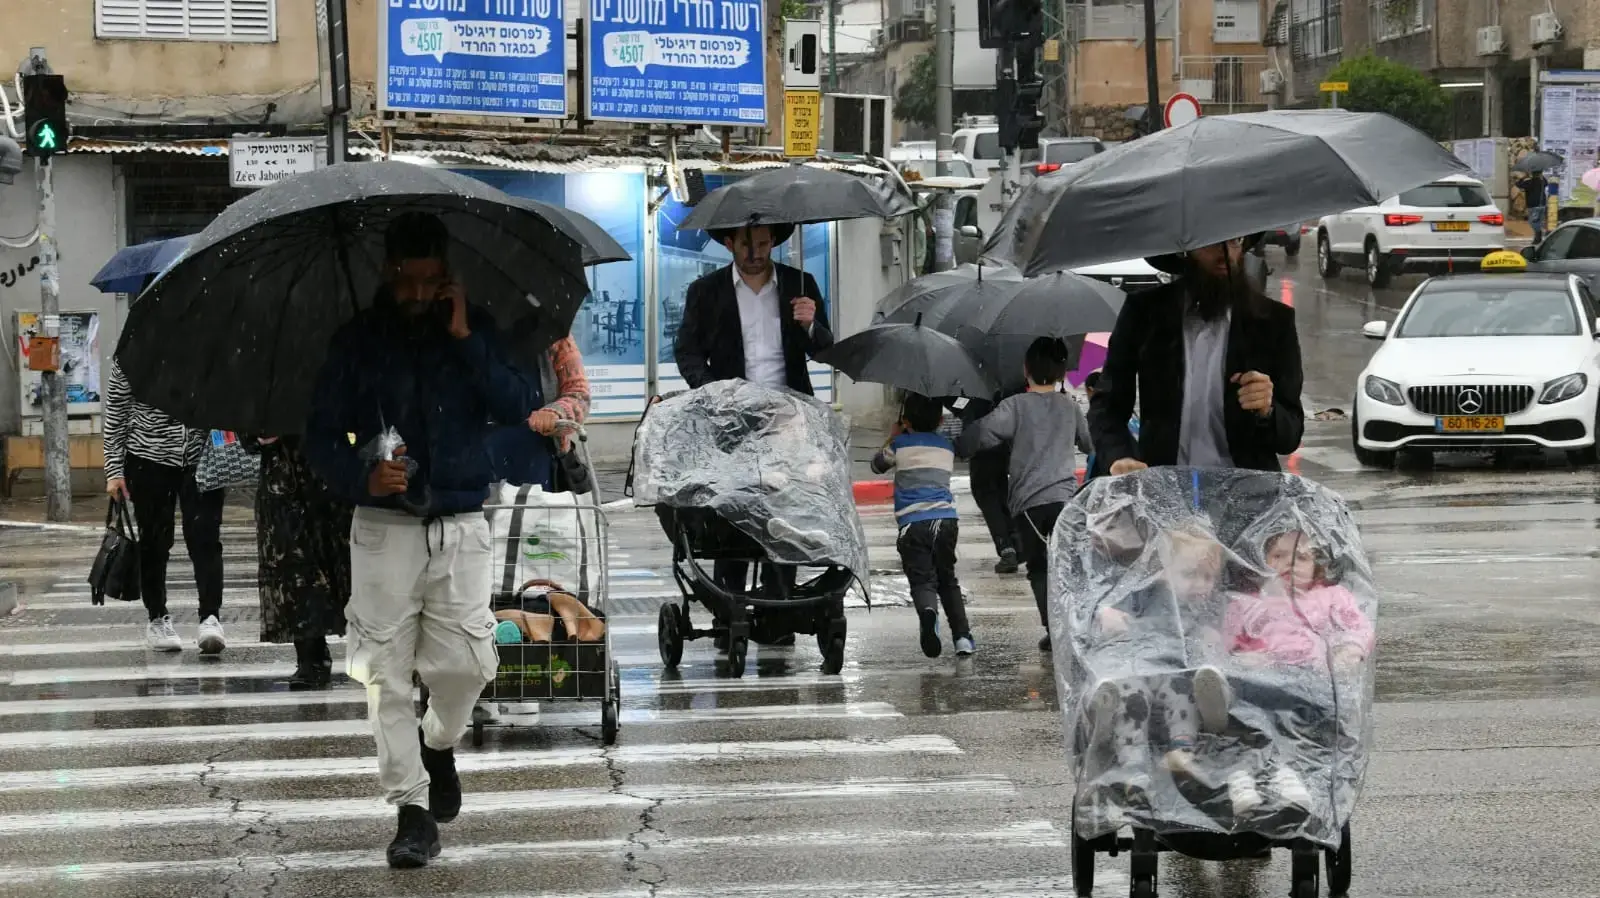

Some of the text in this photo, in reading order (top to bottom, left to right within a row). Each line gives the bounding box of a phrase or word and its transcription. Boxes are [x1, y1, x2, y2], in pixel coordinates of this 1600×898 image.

[673, 0, 714, 29] חדרי
[720, 1, 760, 32] רשת
[454, 22, 543, 40] לפרסום דיגיטלי
[461, 40, 537, 54] במגזר החרדי
[655, 36, 742, 52] לפרסום דיגיטלי
[662, 52, 736, 65] במגזר החרדי
[248, 144, 295, 156] ז'בוטינסקי
[297, 144, 313, 153] זאב
[236, 170, 256, 182] Ze'ev
